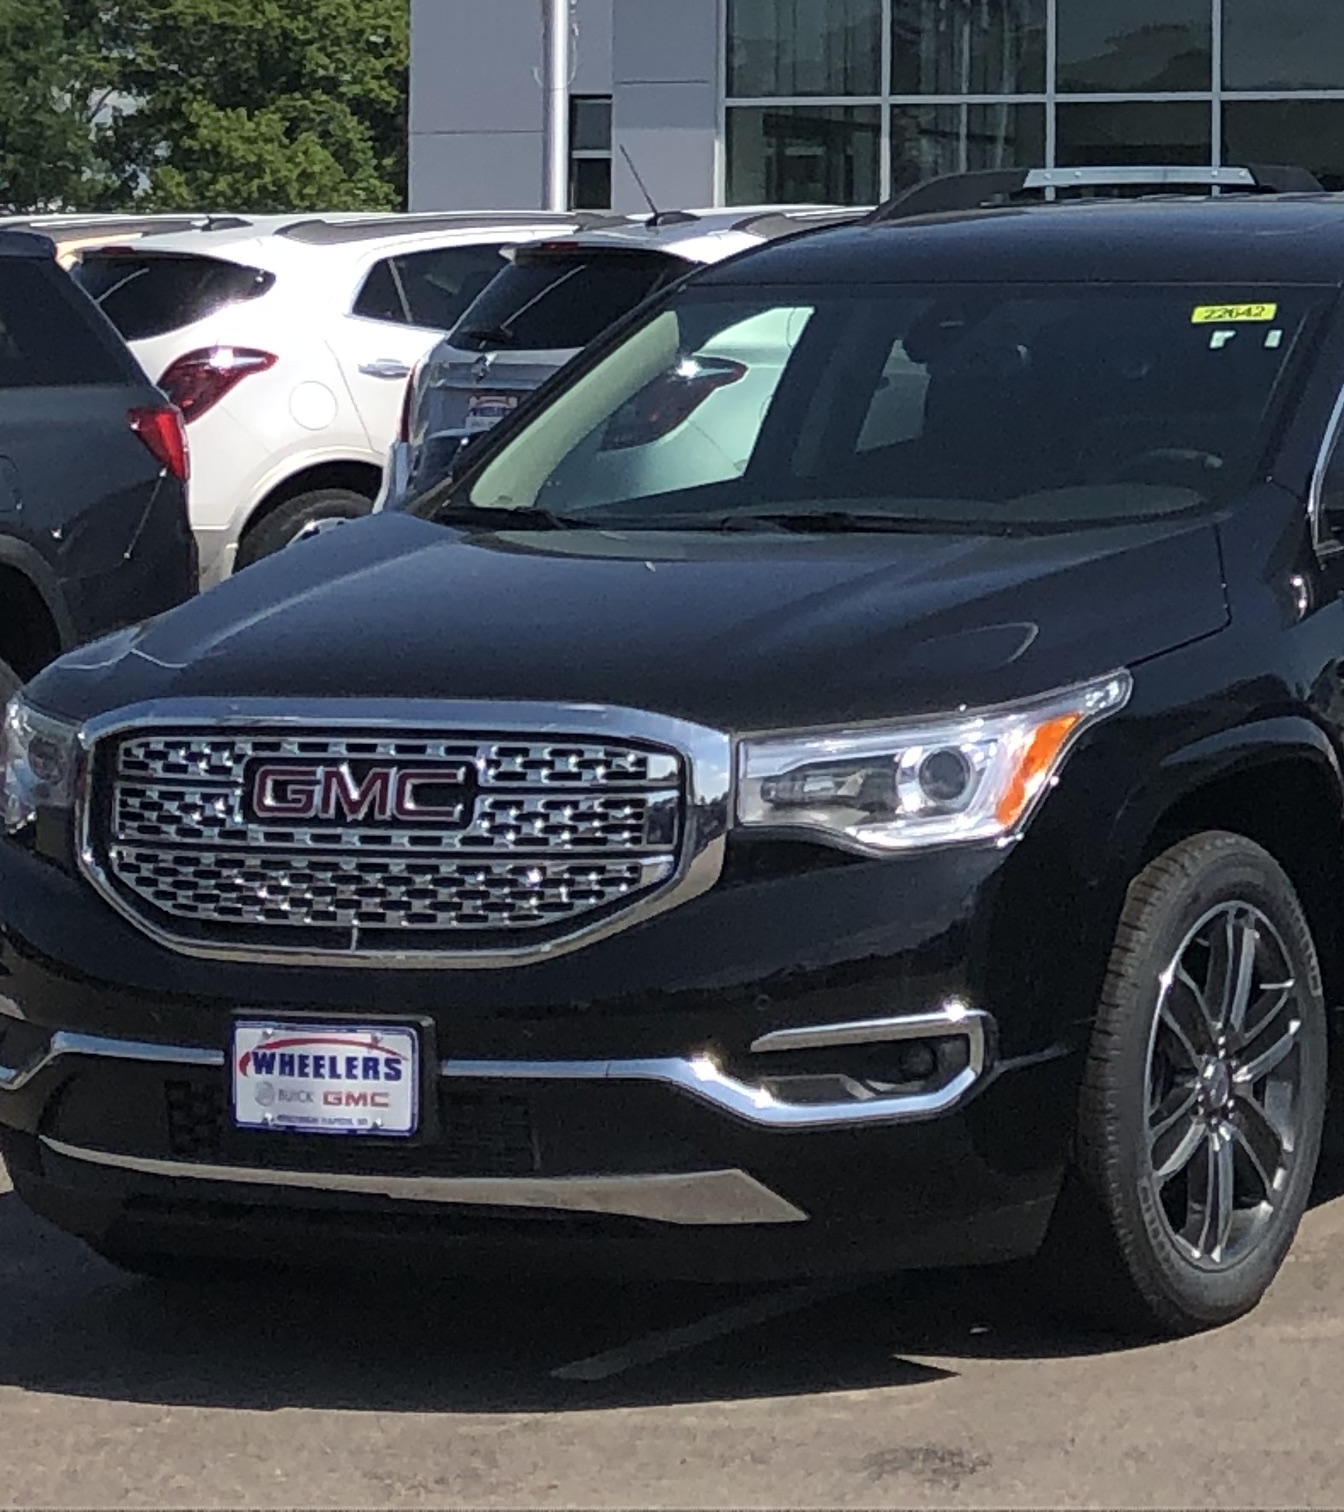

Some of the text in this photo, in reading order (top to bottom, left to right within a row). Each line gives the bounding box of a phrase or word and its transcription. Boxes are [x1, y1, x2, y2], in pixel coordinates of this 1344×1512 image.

[253, 762, 467, 823] GMC
[252, 1051, 402, 1081] WHEELERS
[278, 1088, 390, 1107] BUICK GMC
